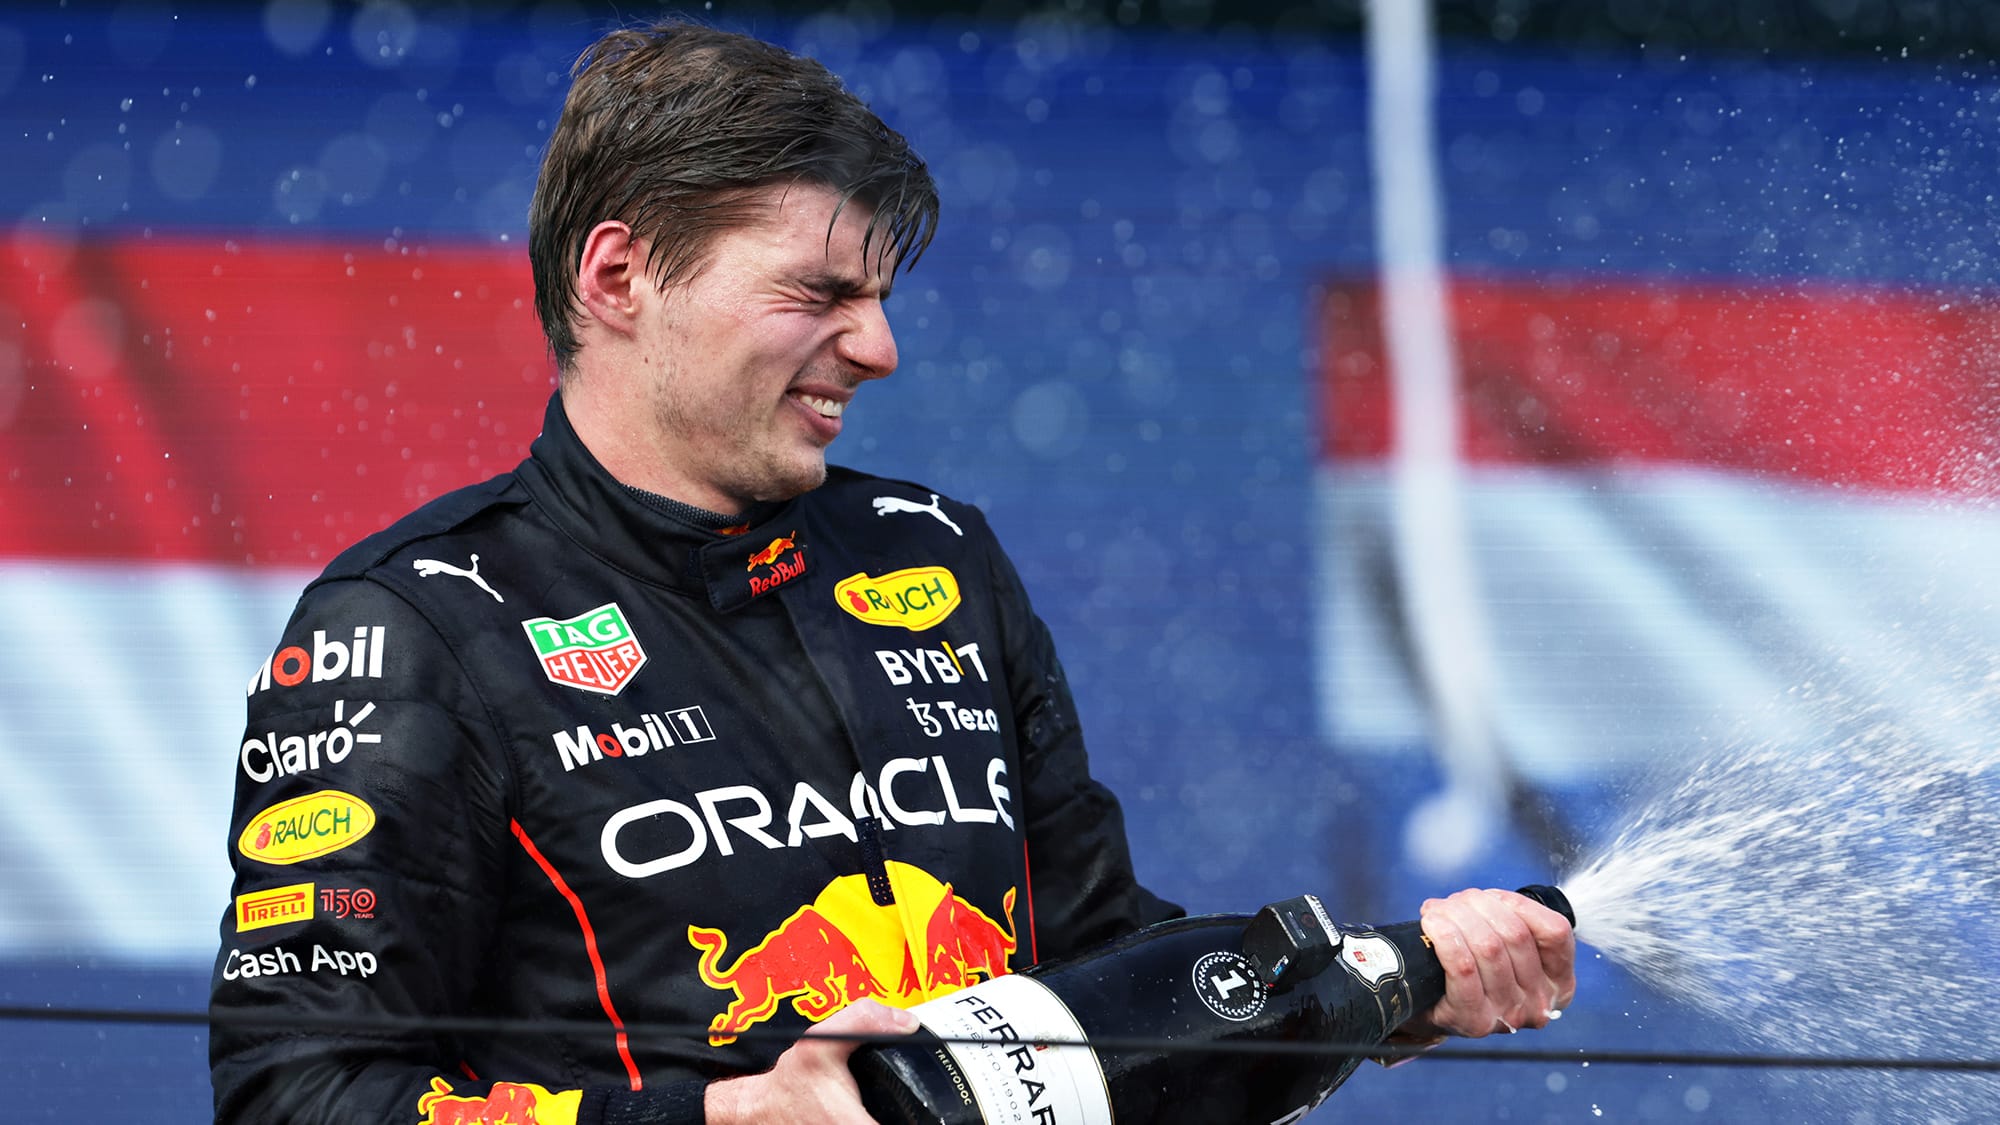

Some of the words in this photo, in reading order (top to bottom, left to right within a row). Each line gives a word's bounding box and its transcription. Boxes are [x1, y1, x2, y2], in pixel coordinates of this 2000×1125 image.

[864, 577, 949, 615] RUCH
[535, 611, 622, 648] TAG
[549, 643, 639, 687] HEUER
[874, 641, 989, 686] BYBIT
[936, 701, 1000, 734] Tezo
[241, 725, 354, 783] Claro
[552, 713, 675, 772] Mobil
[272, 806, 351, 846] RAUCH
[242, 892, 305, 923] PIRELLI
[320, 887, 377, 919] 150
[222, 946, 302, 980] Cash
[311, 944, 378, 978] App
[1210, 969, 1248, 1000] 1
[935, 1049, 972, 1106] TRENTODOC
[957, 1017, 1001, 1072] TRENTO
[1002, 1081, 1022, 1123] 1902
